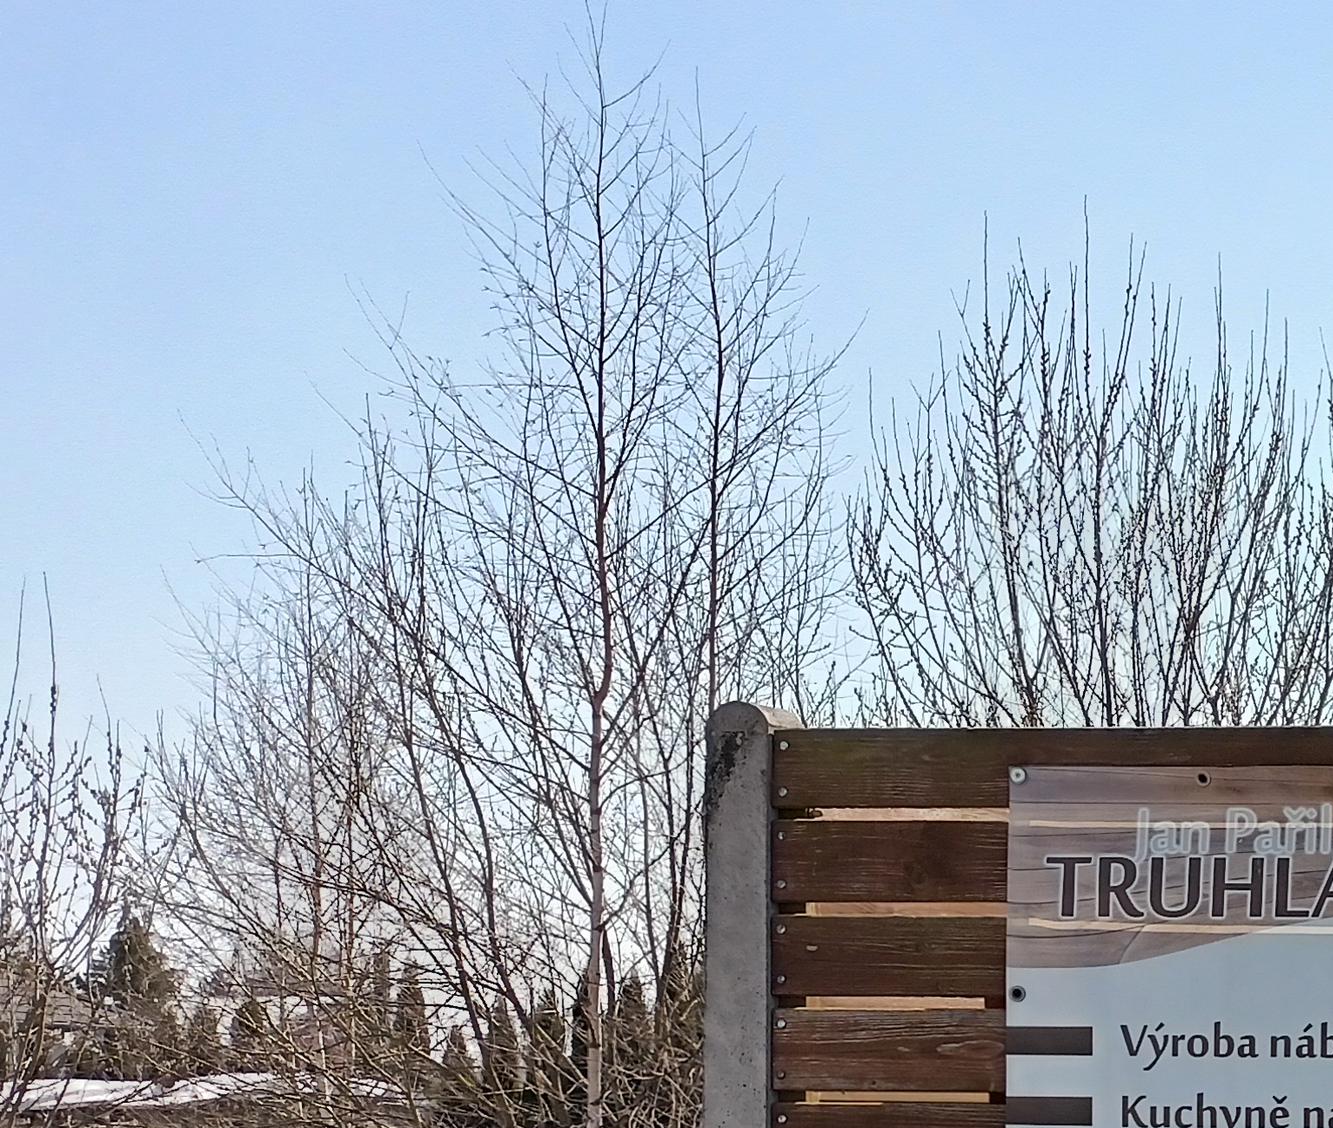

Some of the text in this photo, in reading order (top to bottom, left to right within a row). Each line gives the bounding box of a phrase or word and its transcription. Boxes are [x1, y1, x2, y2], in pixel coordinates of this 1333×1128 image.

[1135, 803, 1333, 863] Jan Pařil
[1120, 1021, 1258, 1071] Výroba
